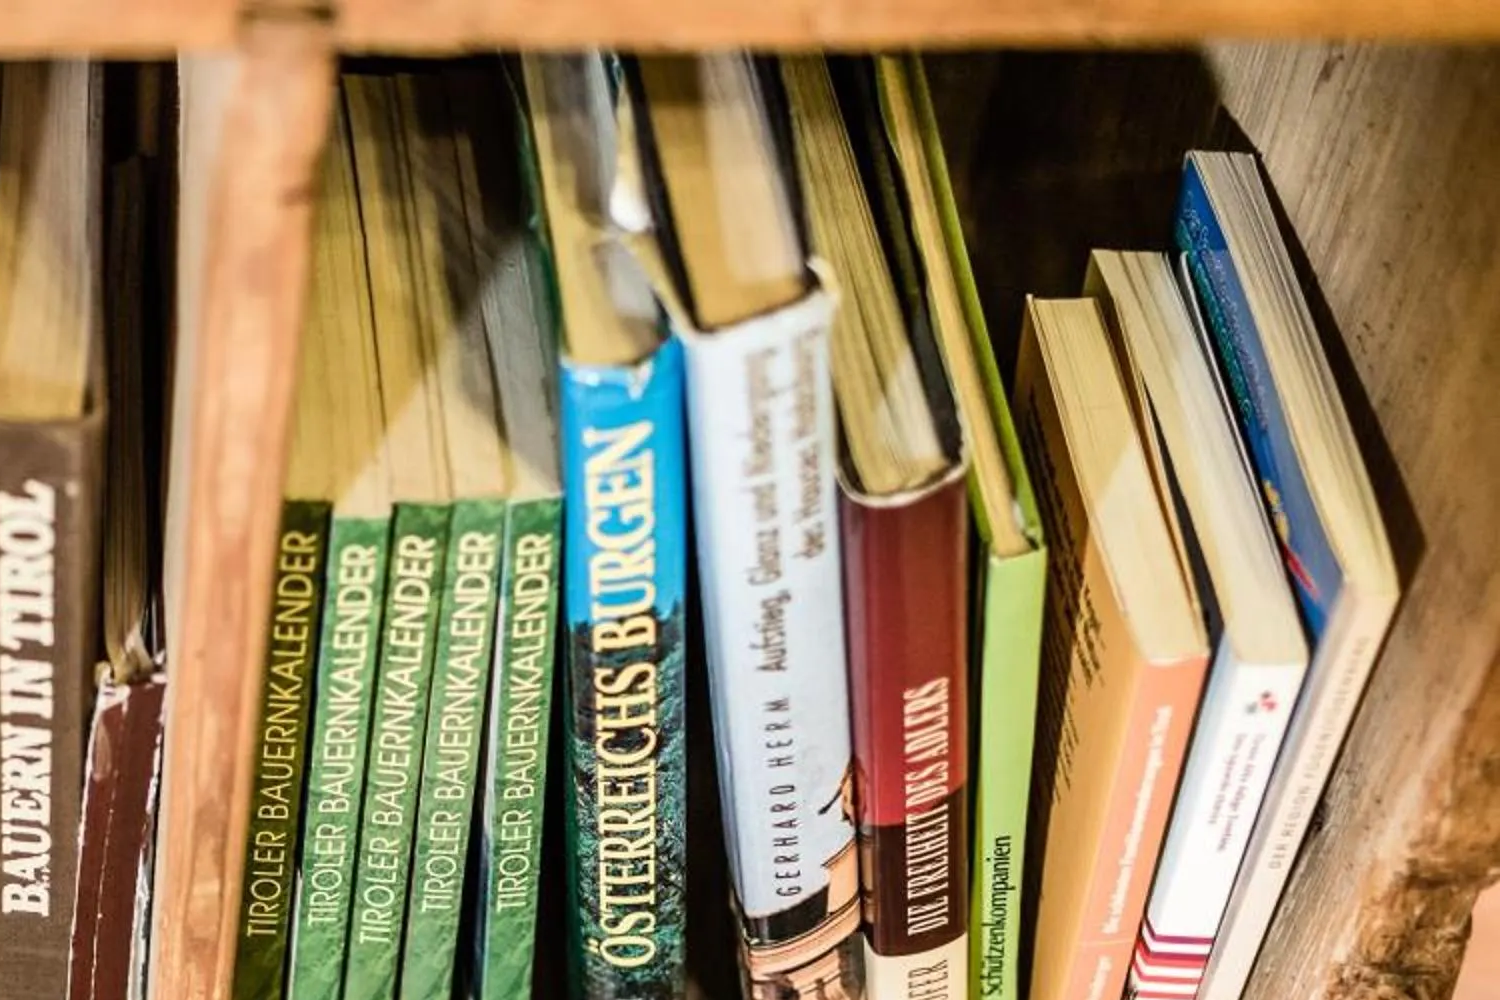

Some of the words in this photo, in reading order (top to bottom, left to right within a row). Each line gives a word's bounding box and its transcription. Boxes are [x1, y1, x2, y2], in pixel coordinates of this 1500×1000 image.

[583, 419, 657, 656] BURGEN
[258, 530, 318, 820] BAUERNKALENDER
[318, 544, 378, 813] BAUERNKALENDER
[372, 534, 436, 826] BAUERNKALENDER
[434, 530, 497, 802] BAUERNKALENDER
[503, 532, 553, 801] BAUERNKALENDER
[903, 676, 949, 763] ADLERS
[764, 697, 794, 768] HERM
[906, 760, 949, 809] DES
[1, 724, 53, 918] BAUERN
[422, 811, 462, 913] TIROLER
[497, 808, 534, 912] TIROLER
[583, 667, 657, 968] ÖSTERREICHS
[769, 784, 801, 896] GERHARD
[906, 803, 949, 900] FREIHEIT
[247, 831, 287, 938] TIROLER
[308, 823, 349, 927] TIROLER
[359, 837, 399, 945] TIROLER
[908, 895, 949, 936] DIE
[980, 833, 1017, 999] Schützenkompanien
